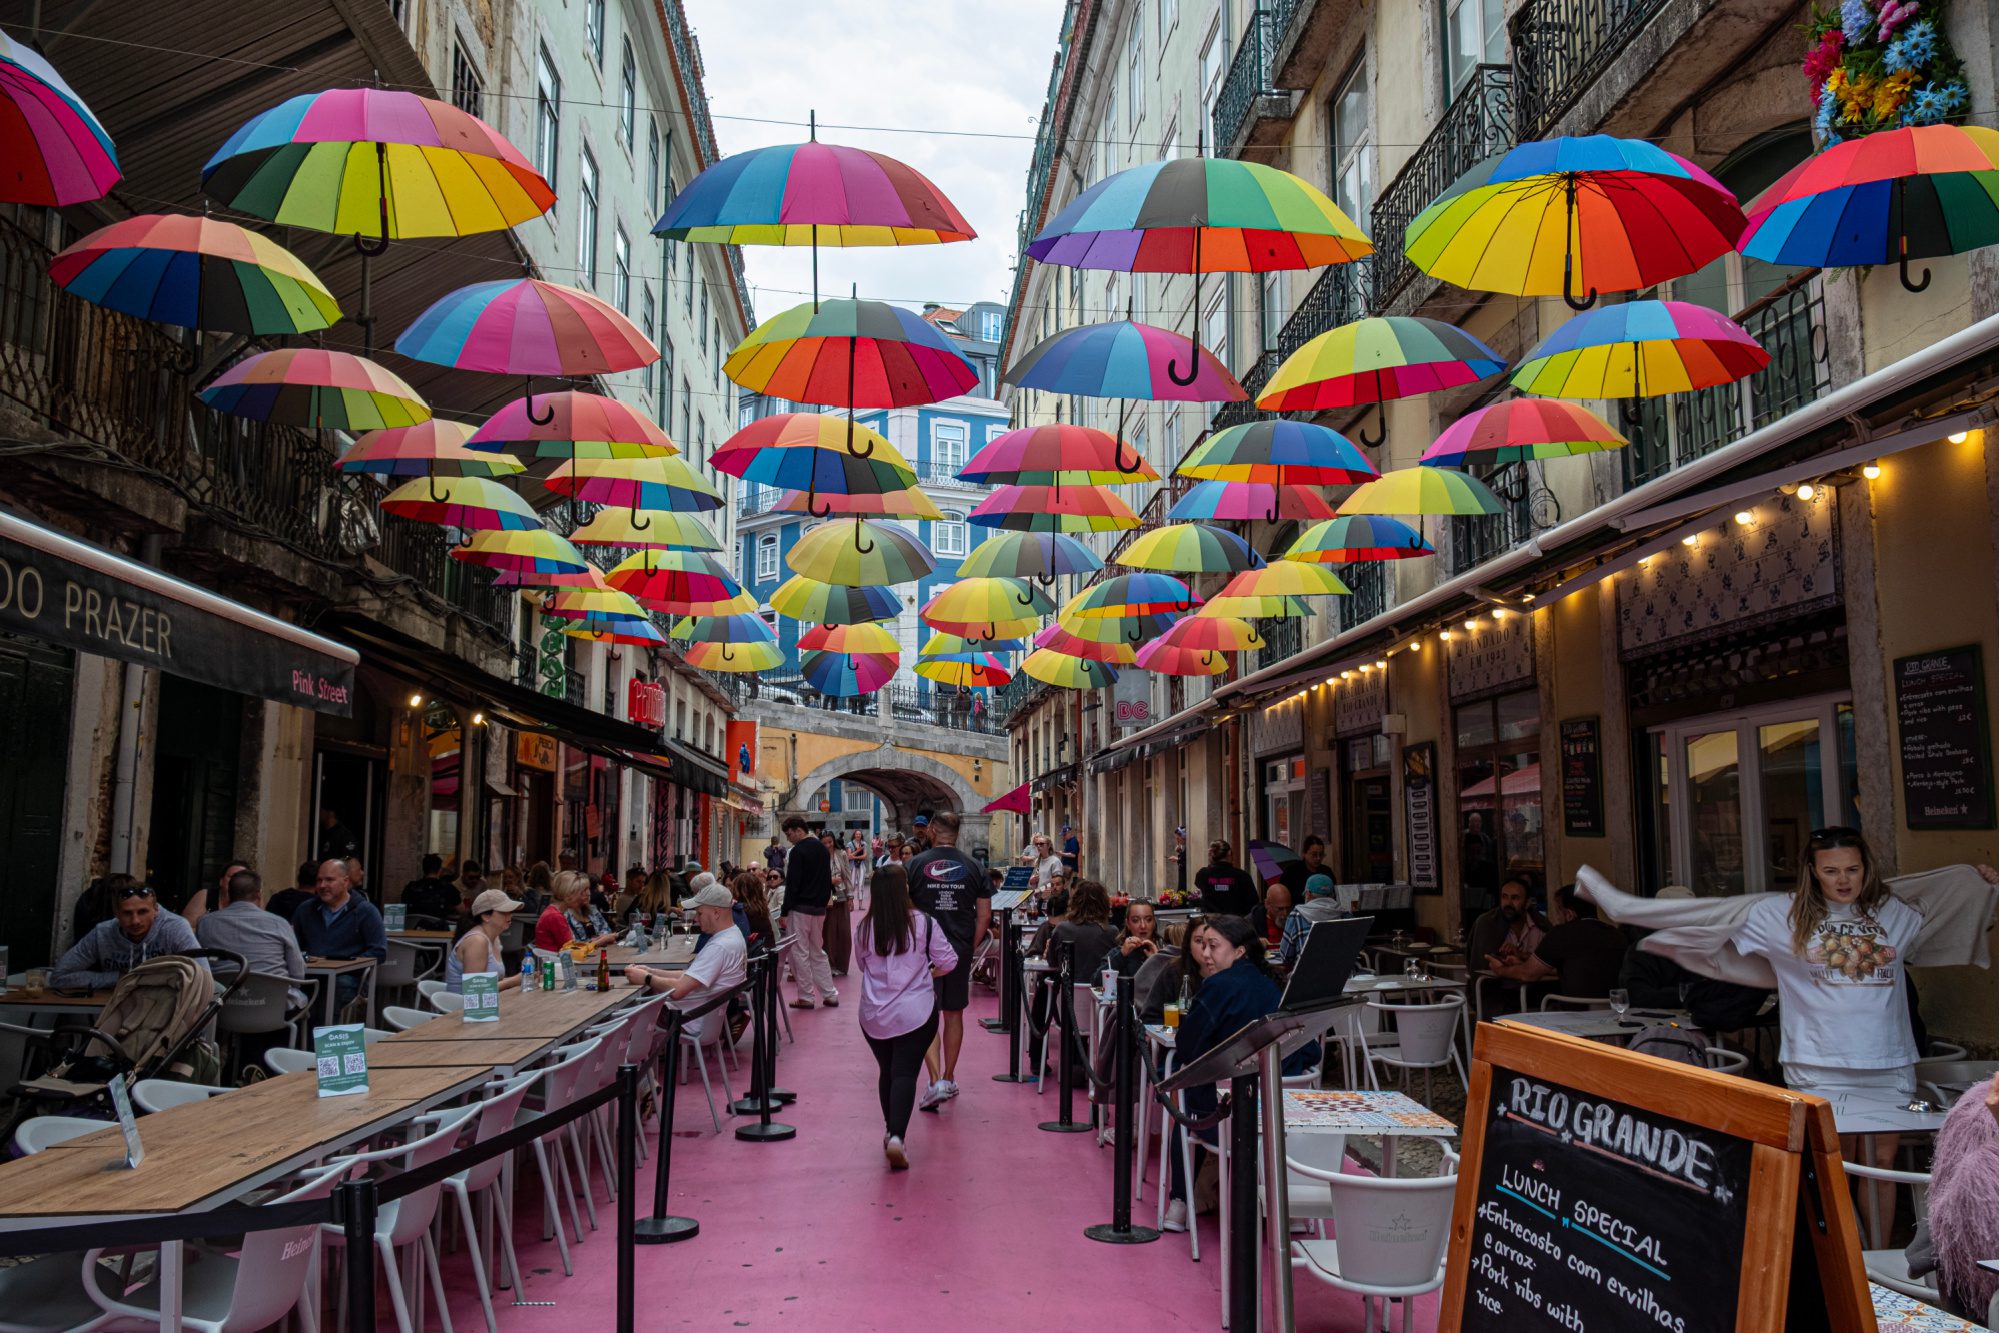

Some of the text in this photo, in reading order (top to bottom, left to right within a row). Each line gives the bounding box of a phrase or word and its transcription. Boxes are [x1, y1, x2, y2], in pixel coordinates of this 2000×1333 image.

[65, 580, 172, 659] PRAZER
[292, 669, 348, 705] Pink Street
[1924, 803, 1959, 816] Heineken
[328, 1032, 350, 1041] OASIS
[1511, 1077, 1715, 1188] RIO GRANDE
[1483, 1232, 1493, 1249] e
[1502, 1163, 1668, 1266] LUNCH SPECIAL
[1480, 1252, 1585, 1333] Pork ribs with
[1486, 1201, 1686, 1333] Entrecosto com ervilhas
